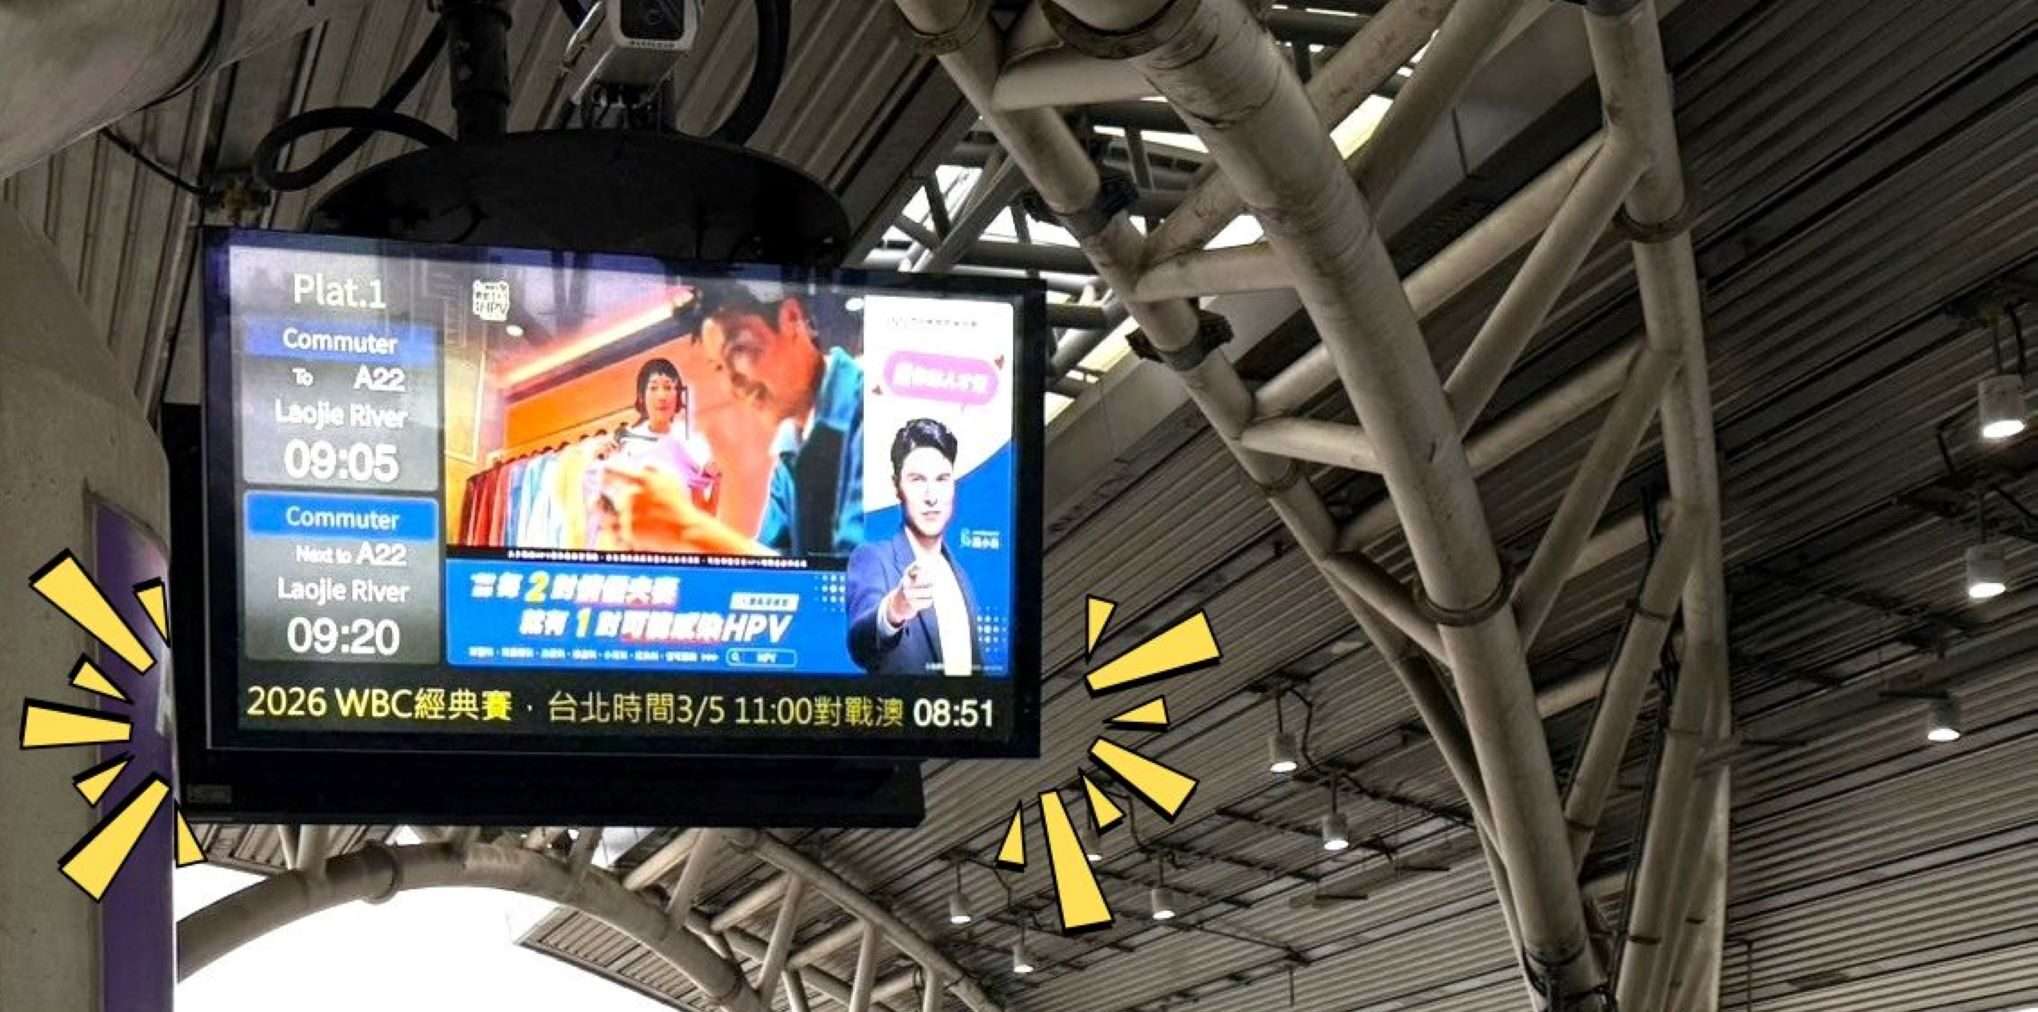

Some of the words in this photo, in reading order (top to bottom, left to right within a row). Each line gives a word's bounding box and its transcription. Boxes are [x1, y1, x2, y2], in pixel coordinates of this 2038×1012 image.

[293, 272, 386, 309] Plat.1
[282, 327, 399, 355] Commuter
[292, 366, 314, 386] To
[353, 364, 406, 392] A22
[274, 398, 344, 430] Laojie
[350, 403, 409, 428] River
[284, 438, 399, 482] 09:05
[285, 505, 400, 530] Commuter
[295, 543, 332, 564] Next
[336, 548, 352, 564] to
[356, 541, 407, 566] A22
[277, 576, 346, 606] Laojie
[352, 578, 411, 603] River
[287, 616, 400, 656] 09:20
[247, 685, 327, 717] 2026
[913, 697, 994, 728] 08:51
